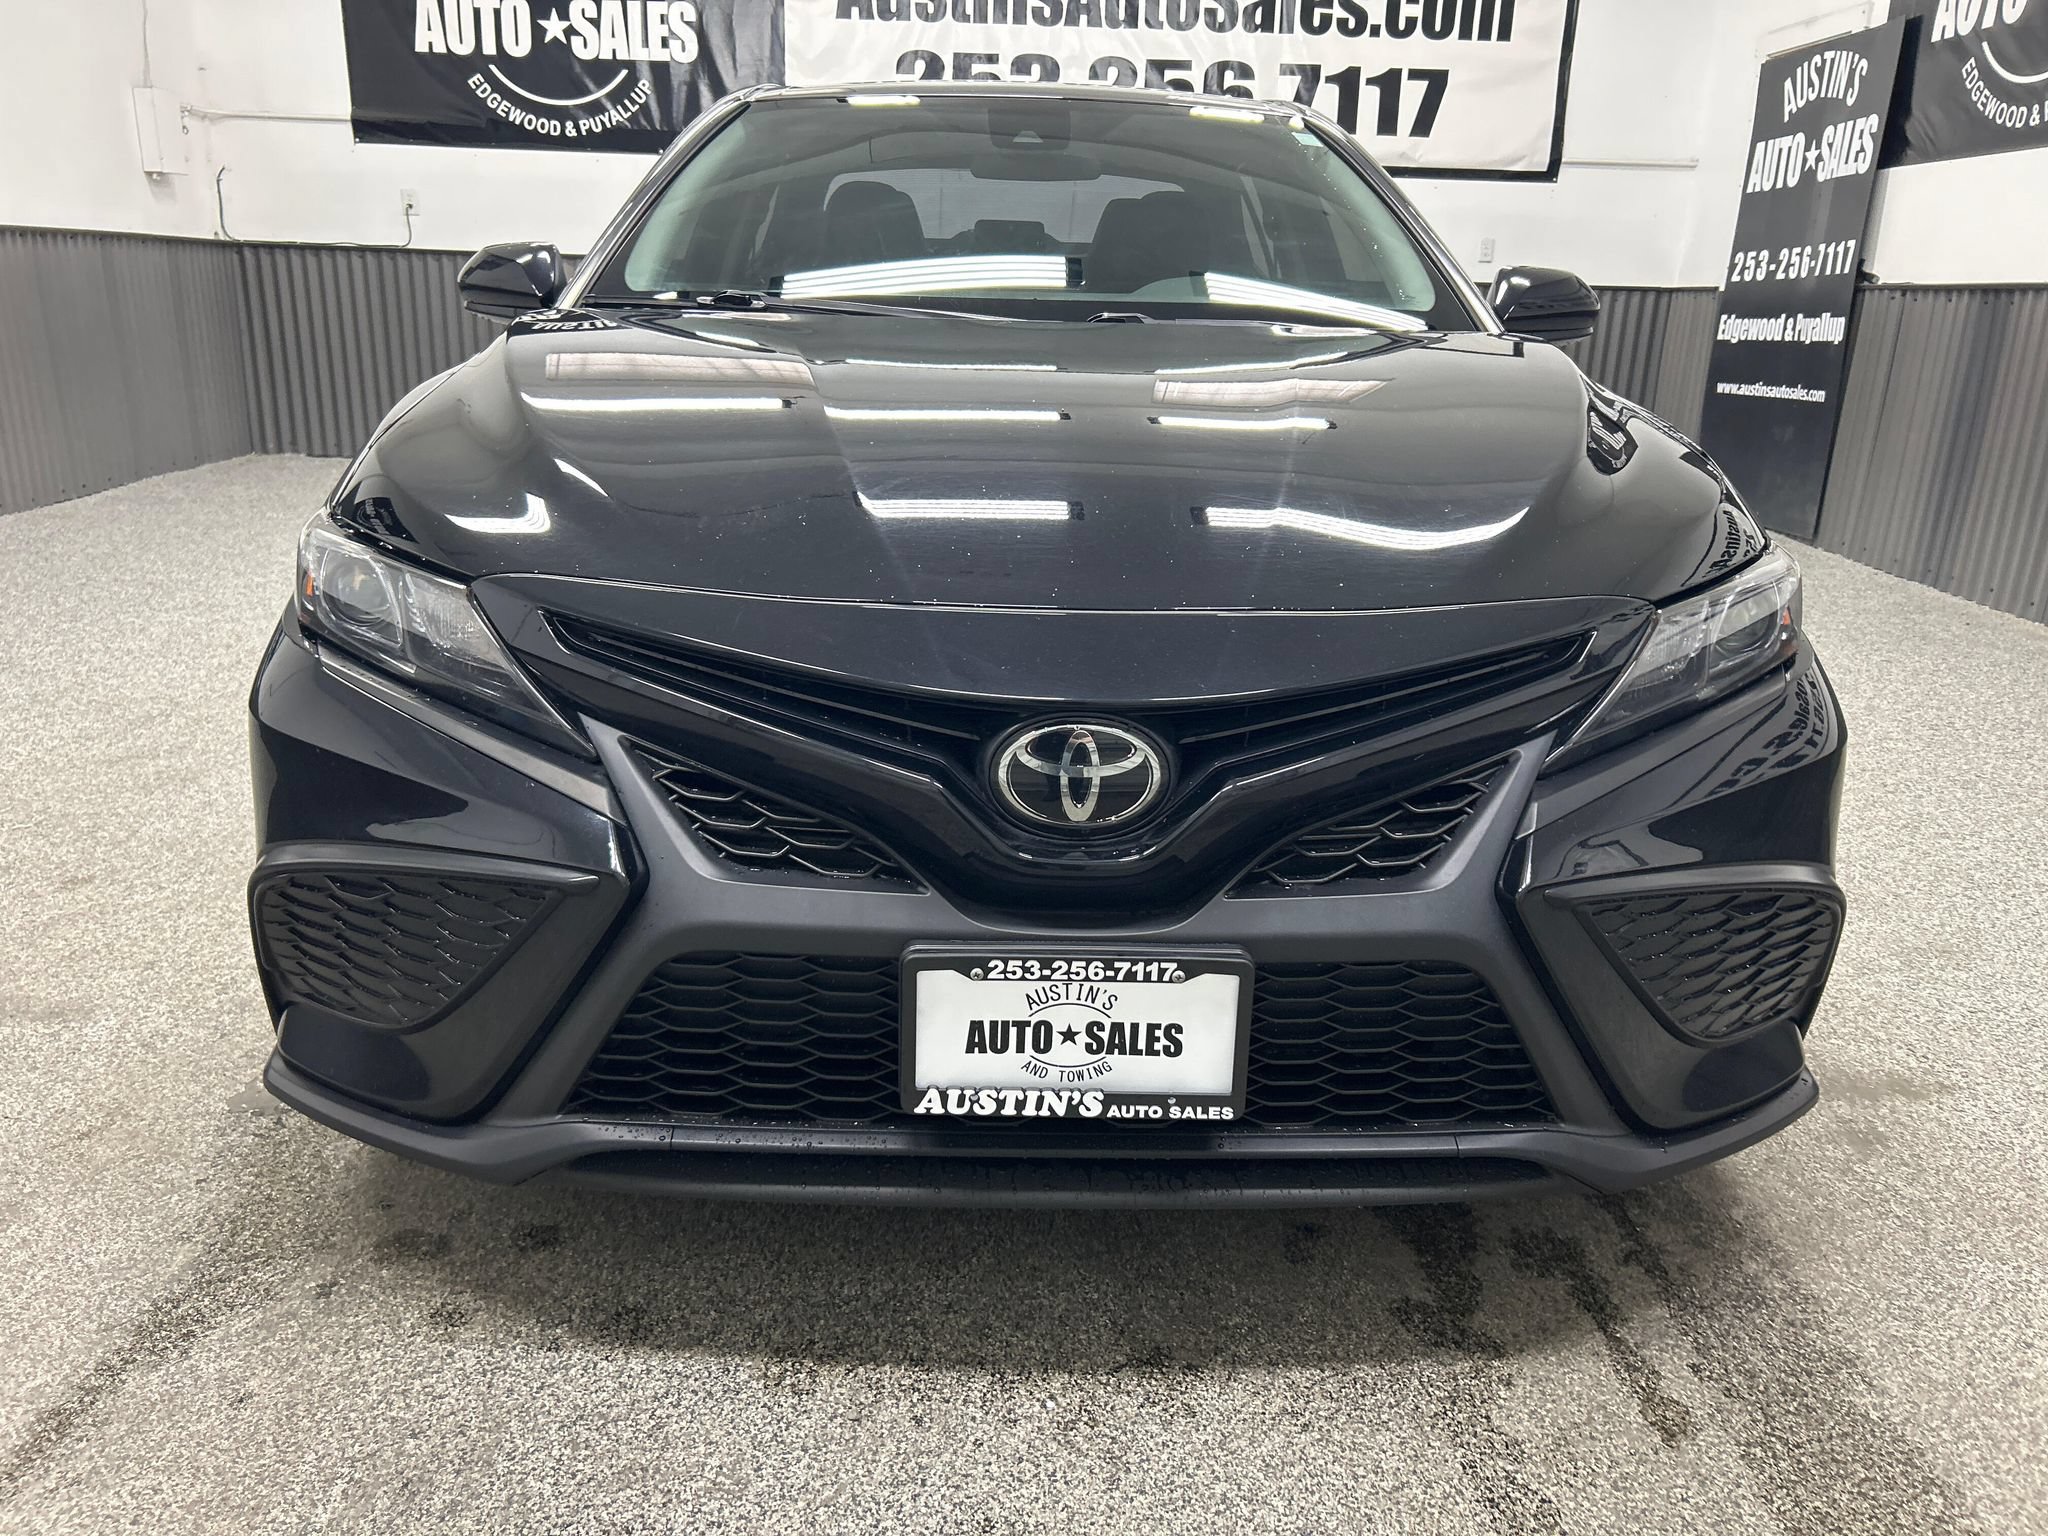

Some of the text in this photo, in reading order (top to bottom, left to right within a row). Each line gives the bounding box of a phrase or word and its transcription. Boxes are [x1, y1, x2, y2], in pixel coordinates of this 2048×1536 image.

[414, 0, 699, 64] AUTO SALES
[467, 73, 654, 137] EDGEWOOD & PUYALLUP
[1783, 50, 1869, 123] AUSTIN'S
[1961, 57, 2028, 128] EDGEWOOD
[2029, 103, 2041, 127] &
[1746, 113, 1879, 193] AUTO SALES
[1731, 239, 1857, 282] 253-256-7117
[1717, 312, 1845, 344] Edgewood & Puyallup
[1717, 381, 1825, 402] www.austinsautosales.com
[987, 959, 1178, 982] 253-256-7117
[1025, 982, 1118, 1011] AUSTIN'S
[965, 1019, 1184, 1058] AUTO SALES
[1021, 1060, 1113, 1083] AND TOWING
[914, 1088, 1235, 1120] AUSTIN'S AUTO SALES
